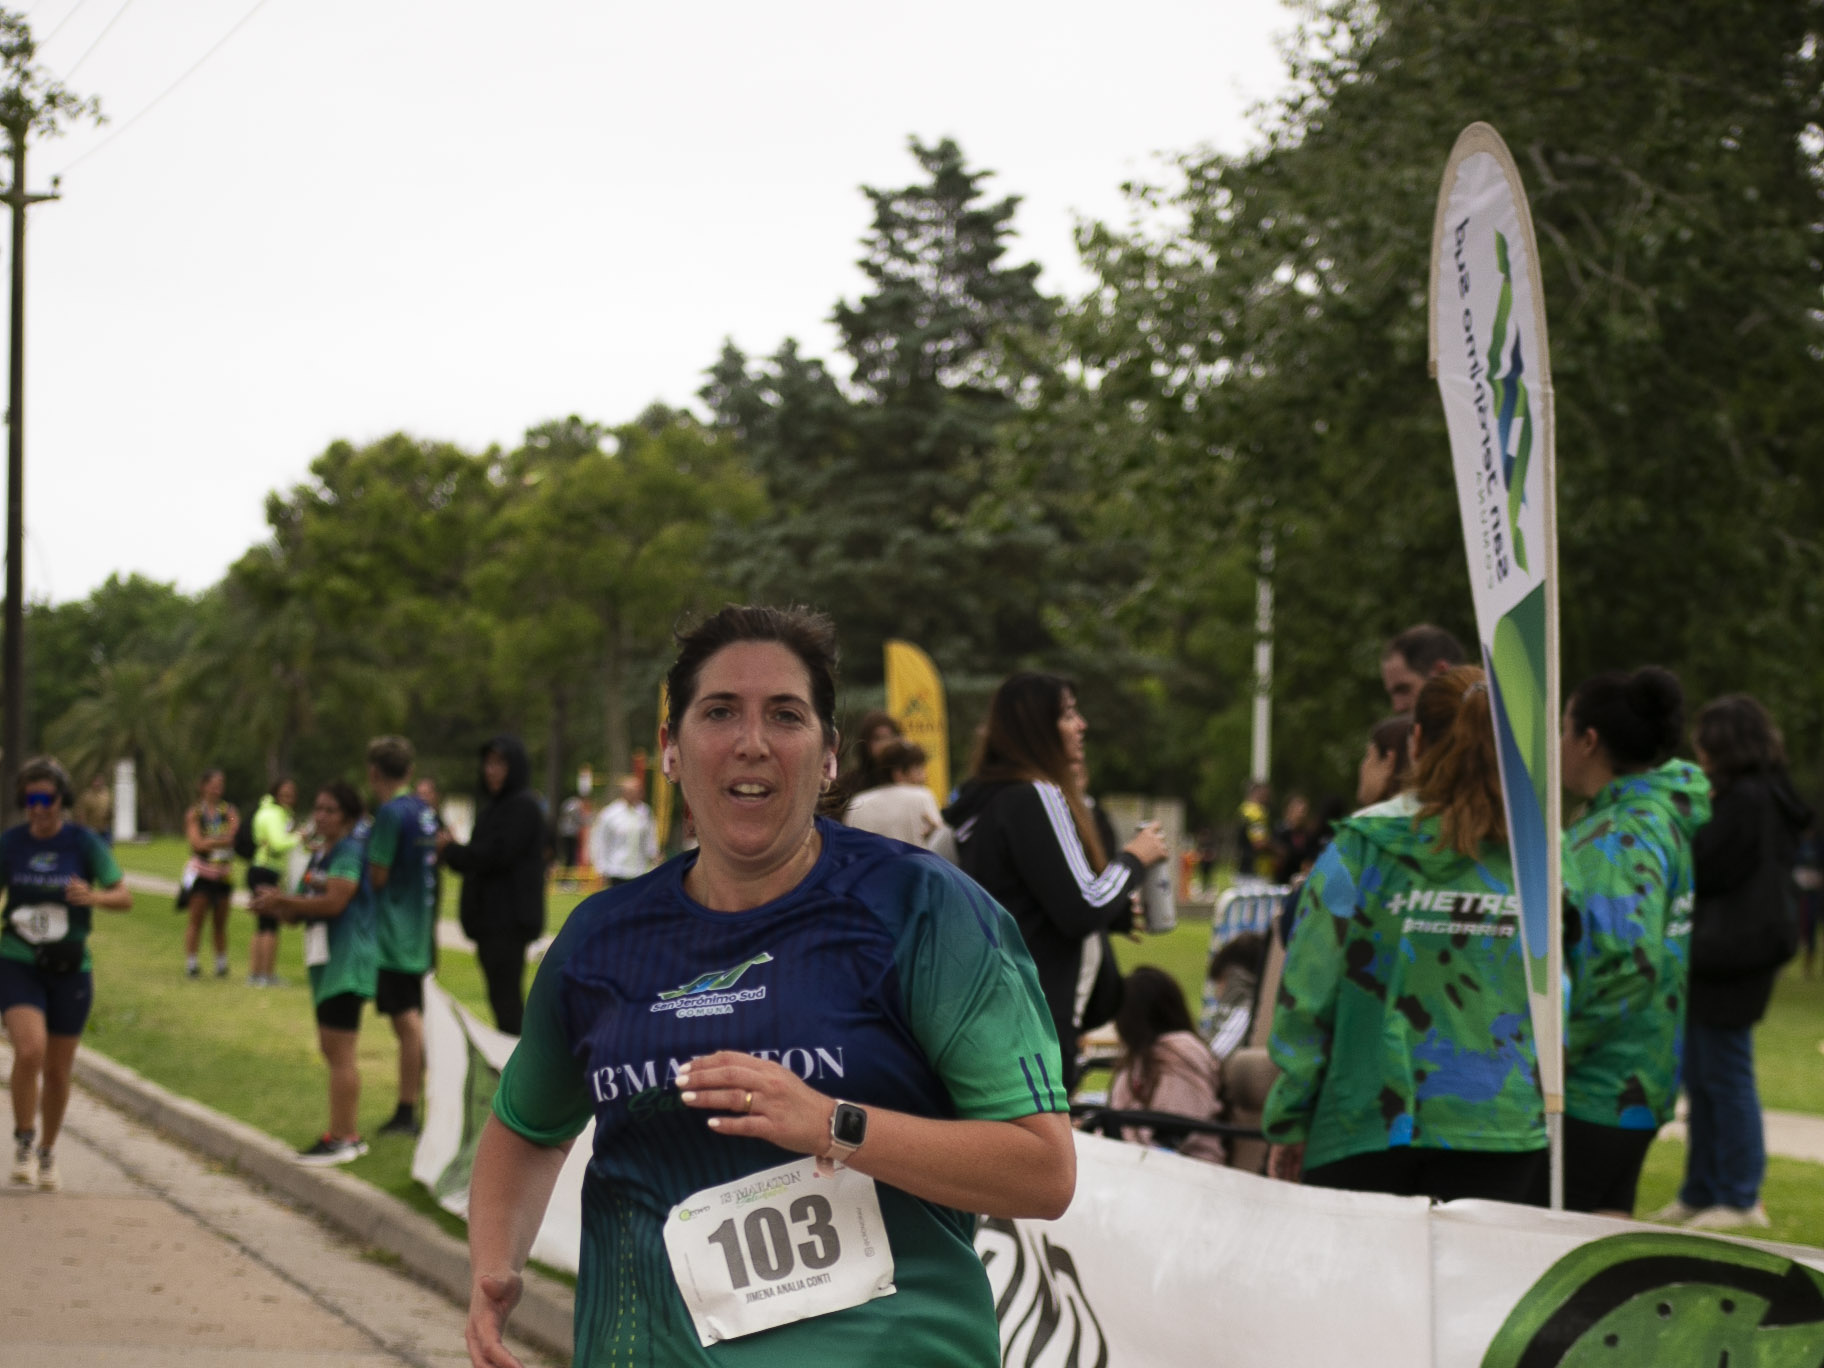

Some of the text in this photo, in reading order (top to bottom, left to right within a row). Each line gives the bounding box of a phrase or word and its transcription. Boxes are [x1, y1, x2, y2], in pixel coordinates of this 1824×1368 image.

[651, 986, 765, 1012] San Jerónimo Sud
[677, 1005, 734, 1018] COMUNA
[707, 1194, 841, 1290] 103
[745, 1287, 776, 1304] JIMENA
[806, 1272, 832, 1289] CONTI
